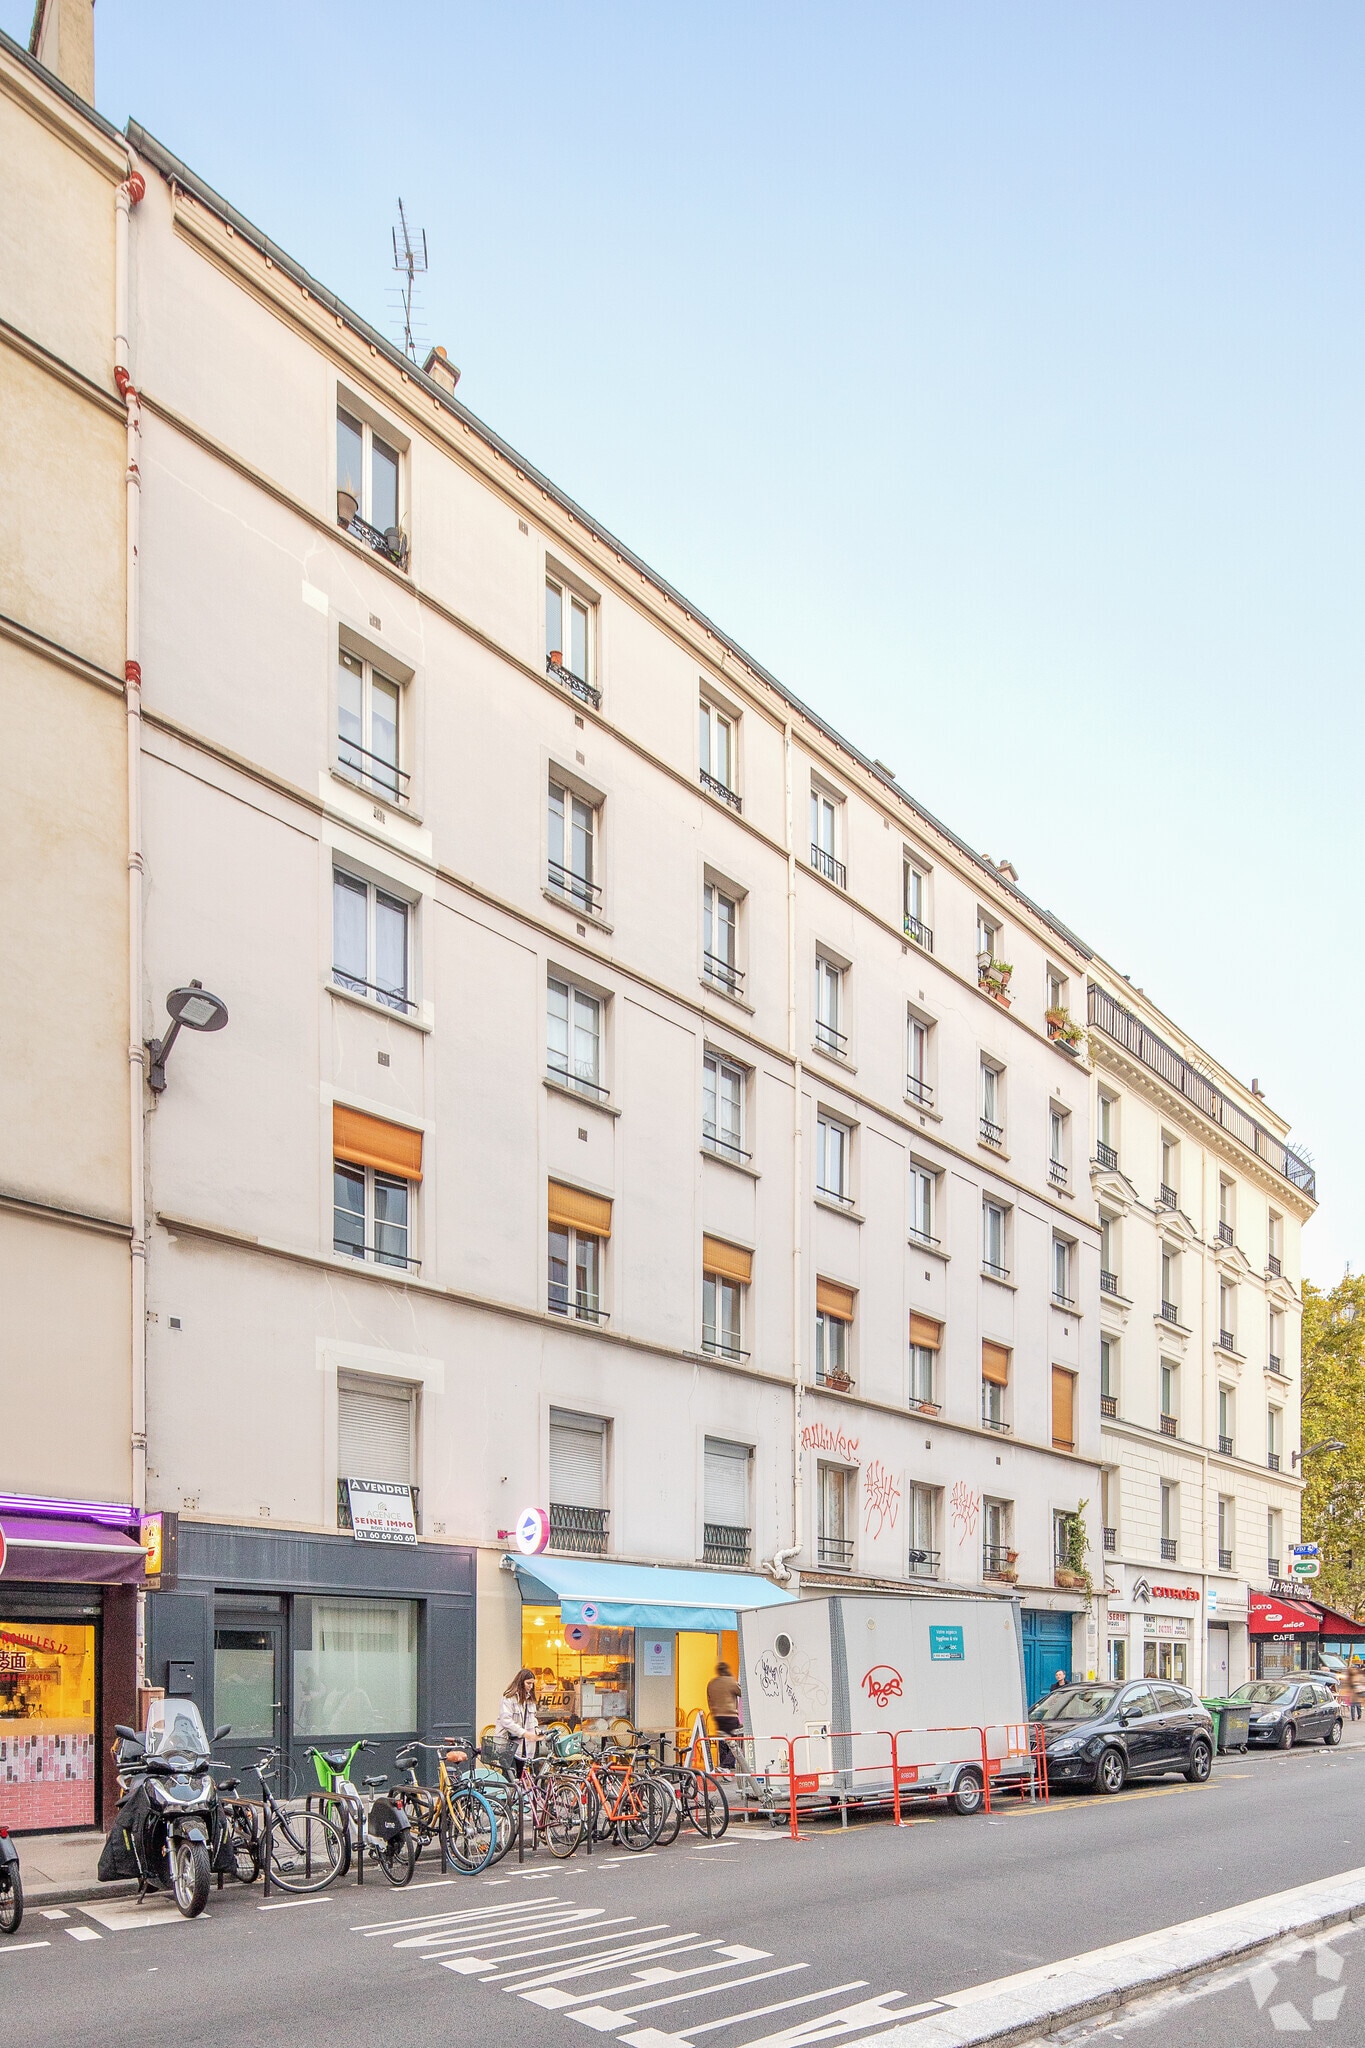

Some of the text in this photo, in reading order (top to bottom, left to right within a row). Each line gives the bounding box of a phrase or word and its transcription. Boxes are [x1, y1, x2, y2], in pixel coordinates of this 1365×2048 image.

[362, 1482, 409, 1495] VENDRE
[366, 1510, 401, 1520] AGENCE
[355, 1517, 413, 1529] SEINE IMMO
[357, 1530, 415, 1542] 01 60 69 60 69
[1271, 1580, 1280, 1592] Le
[1151, 1586, 1200, 1601] CITROËN
[1, 1633, 69, 1655] NOUILLES 12
[537, 1695, 571, 1706] HELLO
